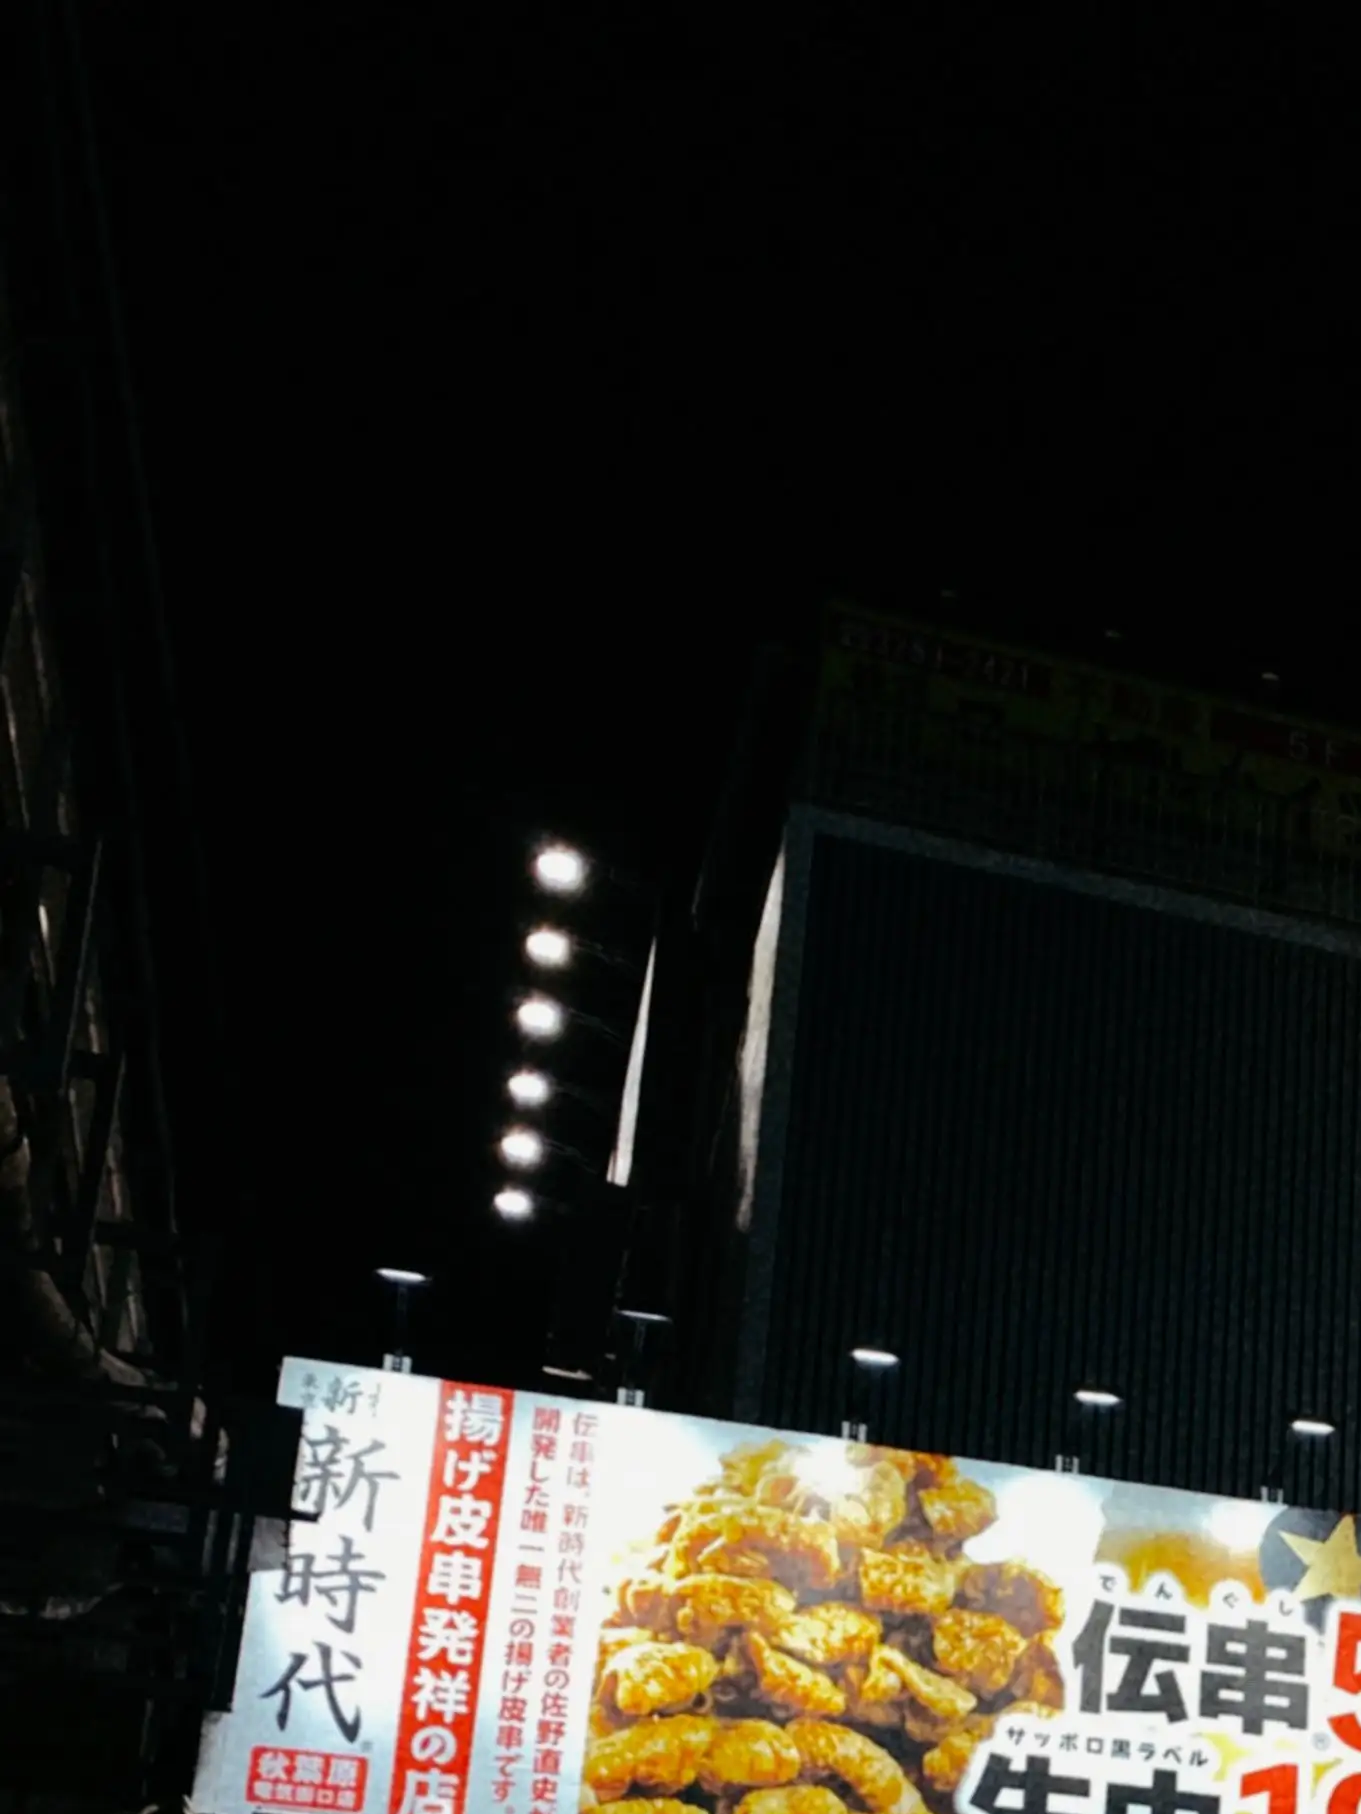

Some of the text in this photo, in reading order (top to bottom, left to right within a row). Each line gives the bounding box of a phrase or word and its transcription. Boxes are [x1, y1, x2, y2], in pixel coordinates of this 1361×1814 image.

[261, 1424, 401, 1746] 新時代
[1071, 1599, 1311, 1736] 伝串
[1006, 1726, 1210, 1769] サッポロ黒ラベル
